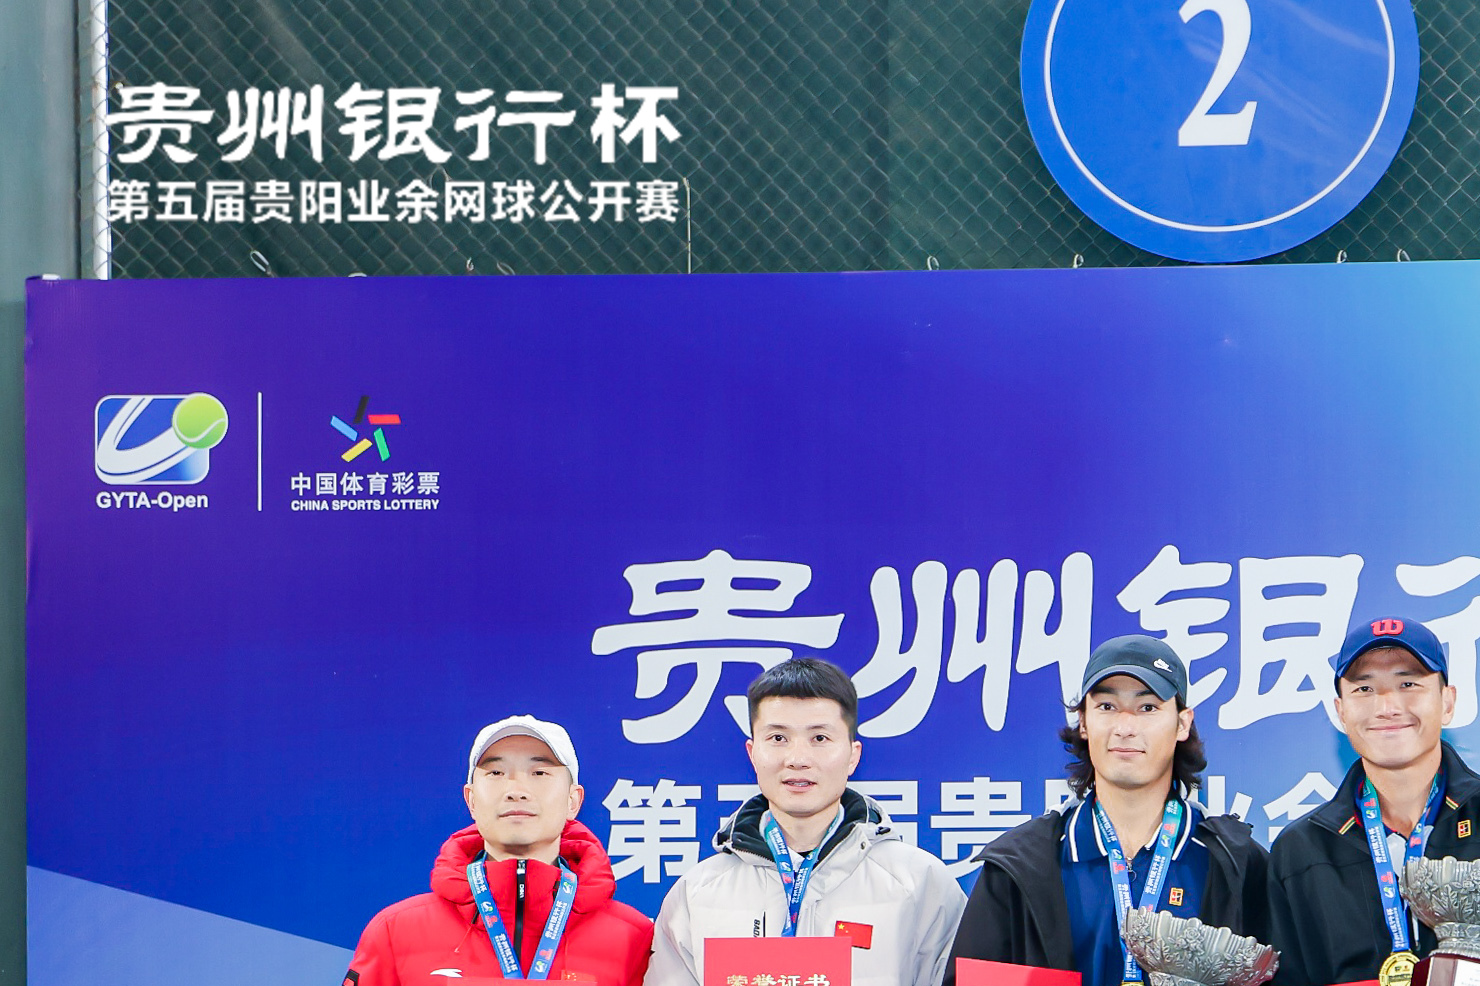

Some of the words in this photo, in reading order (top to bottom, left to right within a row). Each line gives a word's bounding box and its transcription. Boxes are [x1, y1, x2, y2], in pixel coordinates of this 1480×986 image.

[1178, 0, 1258, 147] 2
[291, 472, 440, 496] 中国体育彩票
[96, 491, 209, 511] GYTA-Open
[291, 500, 329, 511] CHINA
[332, 499, 381, 511] SPORTS
[384, 499, 440, 510] LOTTERY
